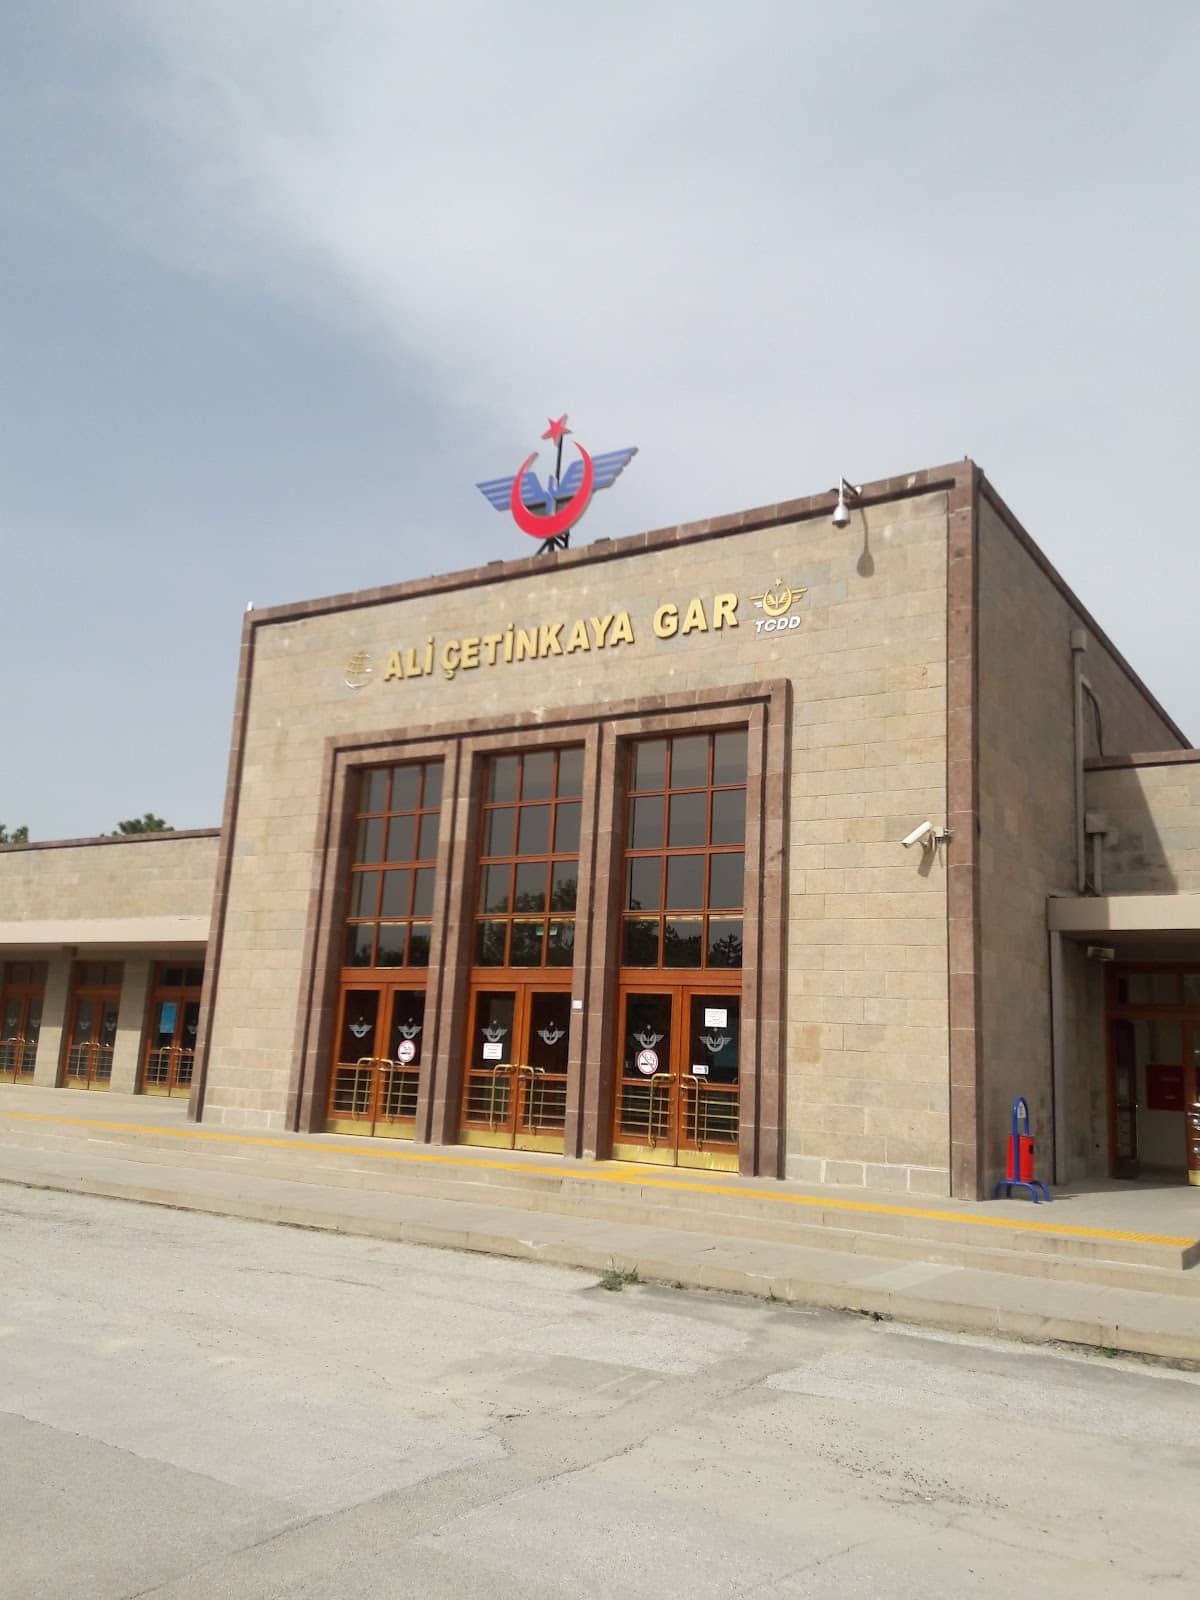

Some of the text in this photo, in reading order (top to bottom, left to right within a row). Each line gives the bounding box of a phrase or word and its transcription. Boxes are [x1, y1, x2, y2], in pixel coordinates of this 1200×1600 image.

[384, 592, 738, 681] ALİ ÇETİNKAYA GAR
[755, 615, 801, 633] TCDD
